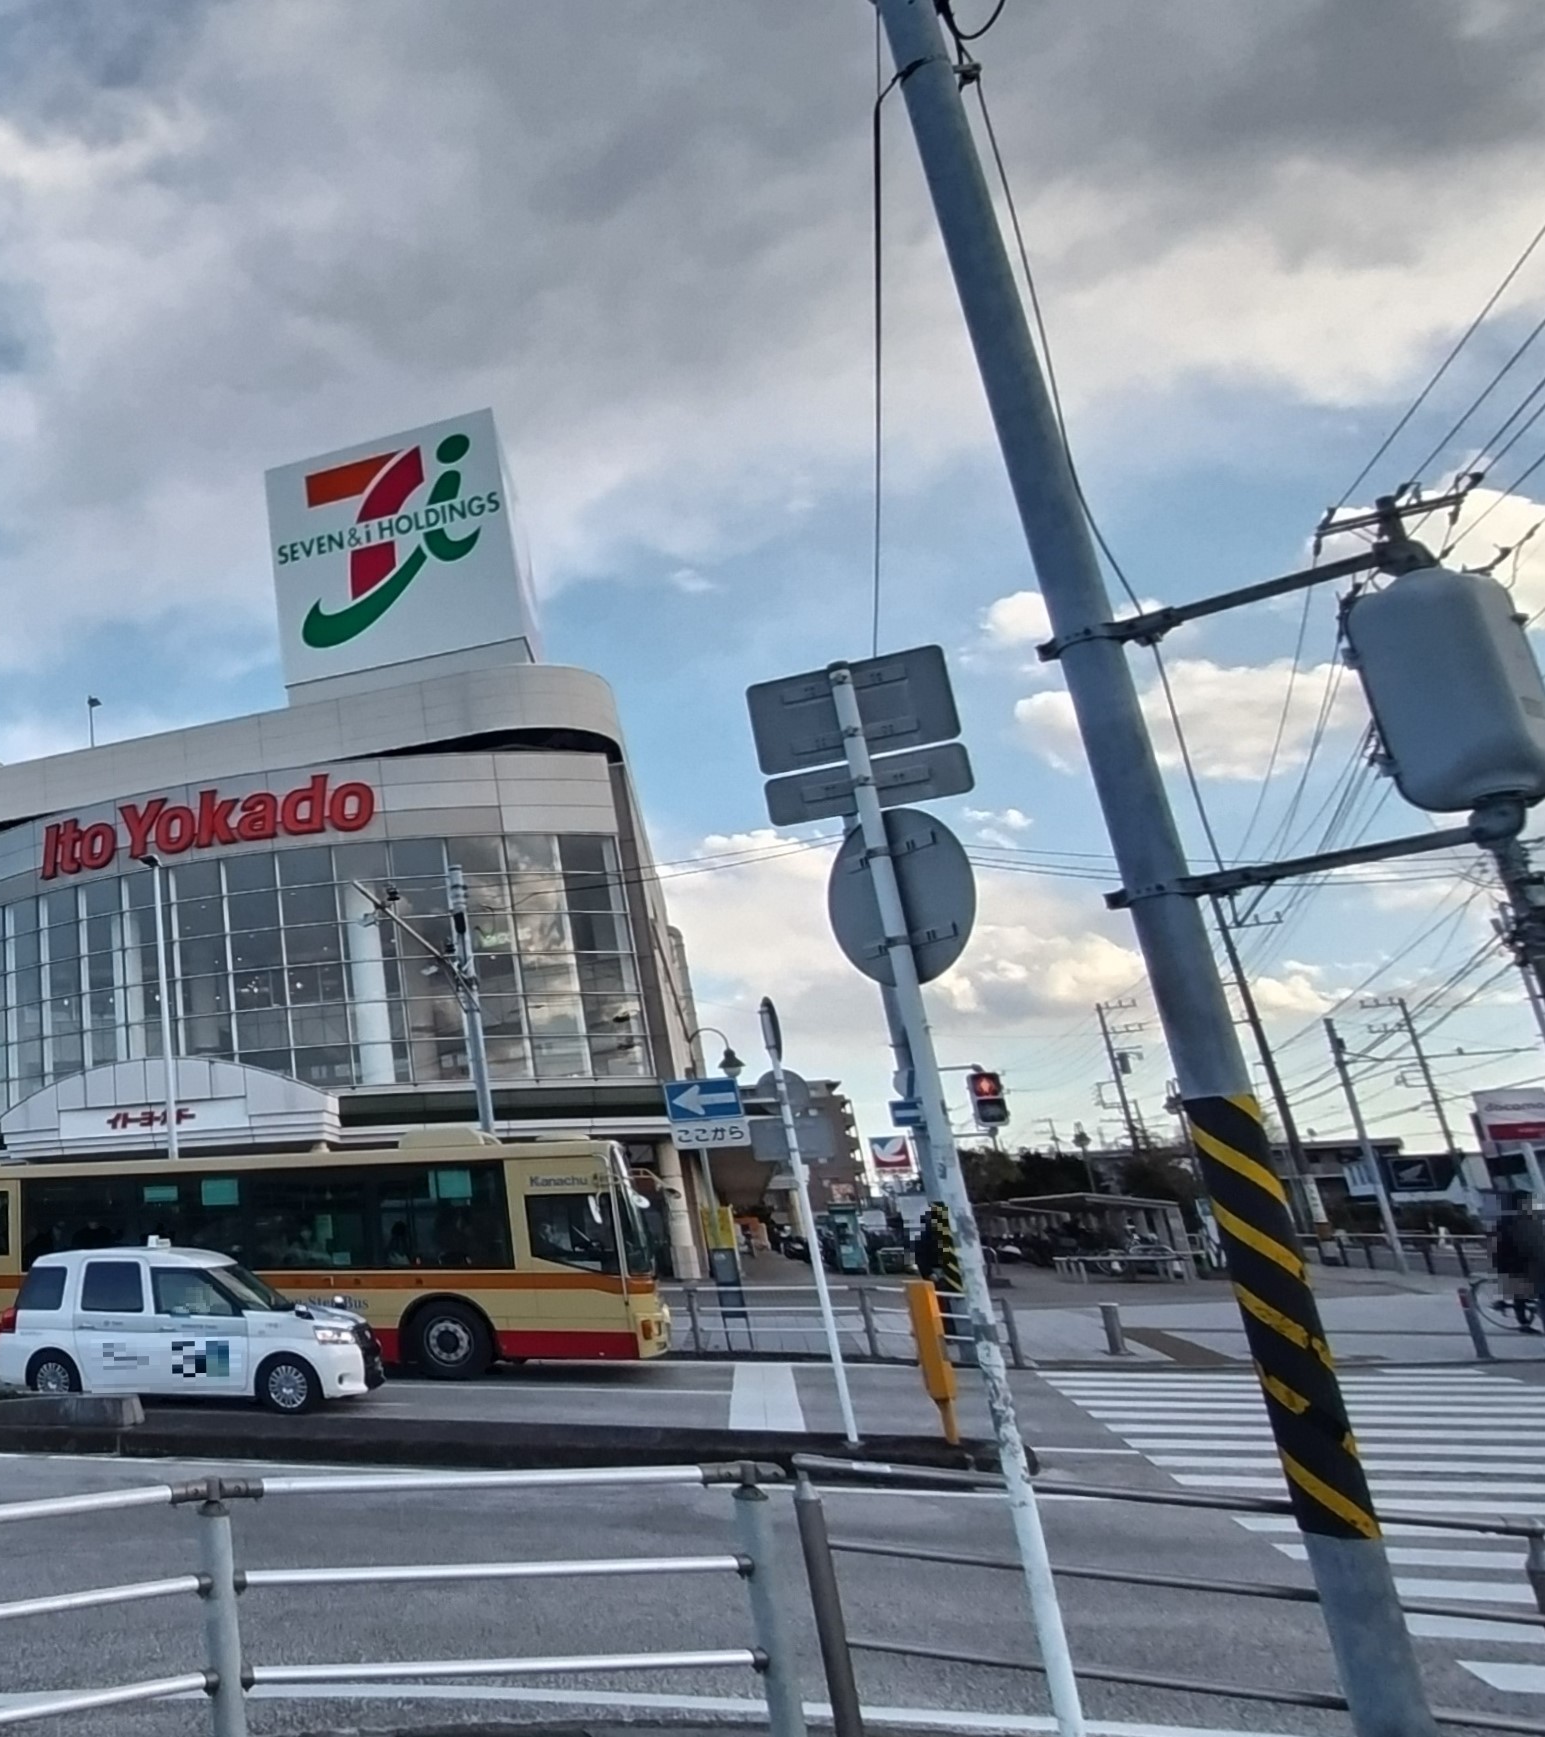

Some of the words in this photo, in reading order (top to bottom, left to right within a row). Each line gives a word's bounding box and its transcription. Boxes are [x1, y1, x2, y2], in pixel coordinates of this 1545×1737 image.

[377, 491, 501, 540] HOLDINGS
[40, 818, 117, 881] Ito
[118, 773, 375, 860] Yokado
[676, 1125, 745, 1143] ここから
[529, 1175, 588, 1187] Kanachu
